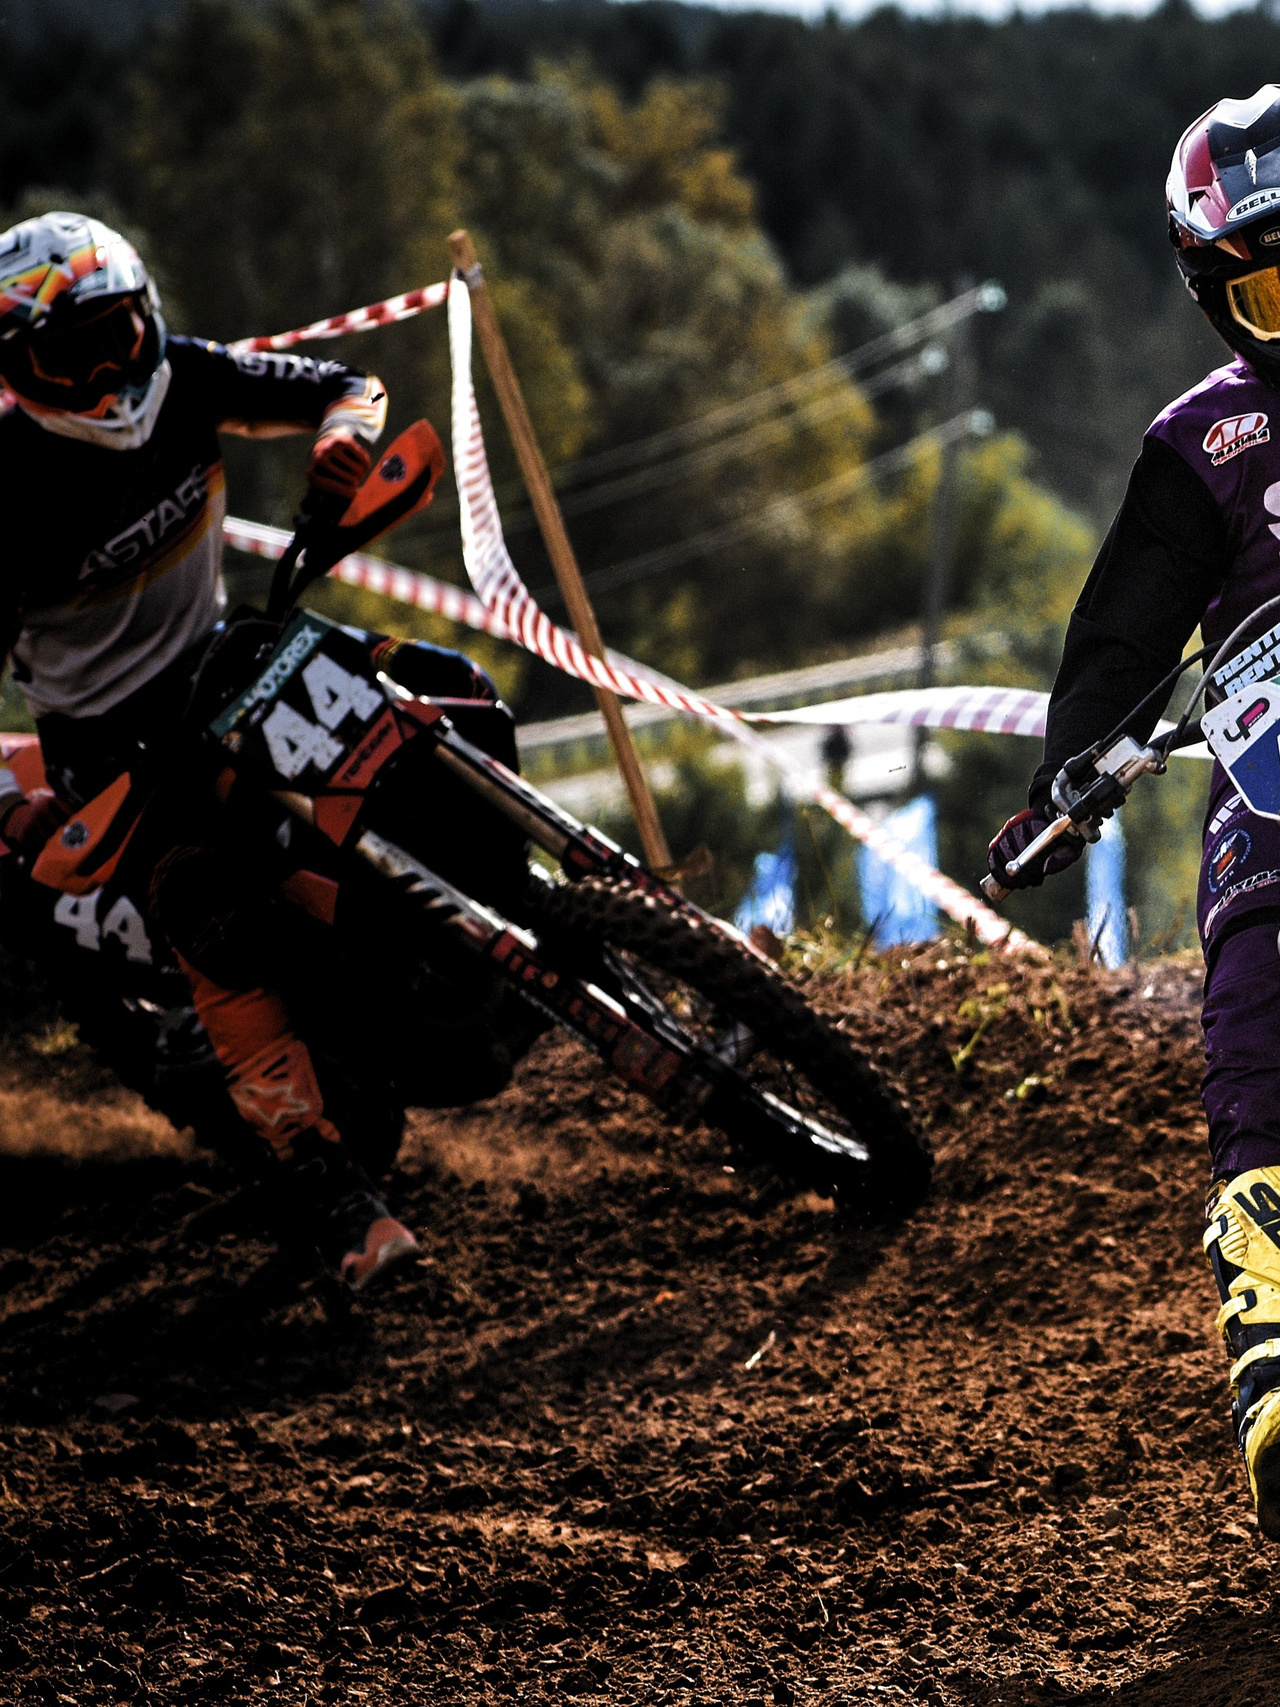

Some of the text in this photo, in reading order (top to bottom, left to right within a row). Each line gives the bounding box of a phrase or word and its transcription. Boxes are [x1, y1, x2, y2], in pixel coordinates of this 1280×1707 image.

[1236, 192, 1280, 216] BELL
[262, 652, 384, 782] 44
[53, 885, 153, 965] 44
